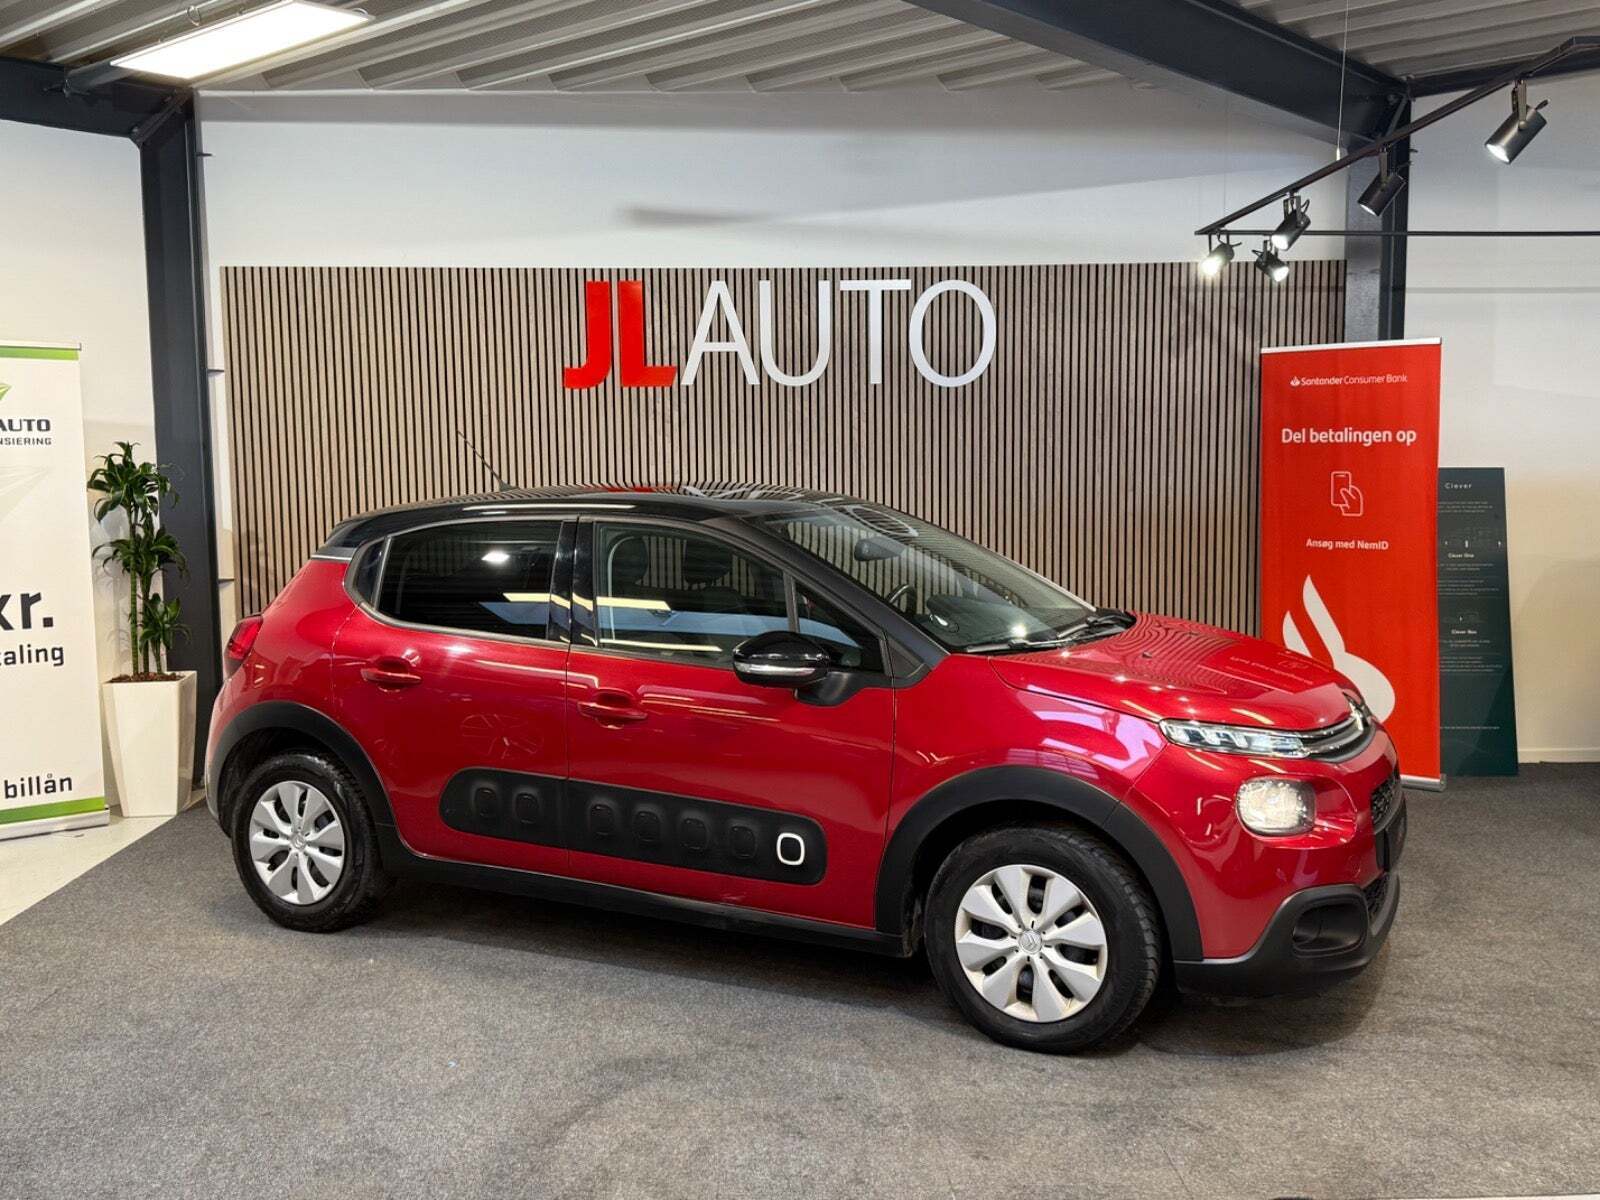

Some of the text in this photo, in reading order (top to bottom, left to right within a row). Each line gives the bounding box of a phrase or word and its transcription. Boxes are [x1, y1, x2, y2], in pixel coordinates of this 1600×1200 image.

[1386, 373, 1408, 383] Bank
[1281, 427, 1417, 447] Del betalingen op
[1306, 538, 1389, 550] Ansøg med NemID
[0, 644, 65, 667] aling
[4, 773, 73, 799] billån
